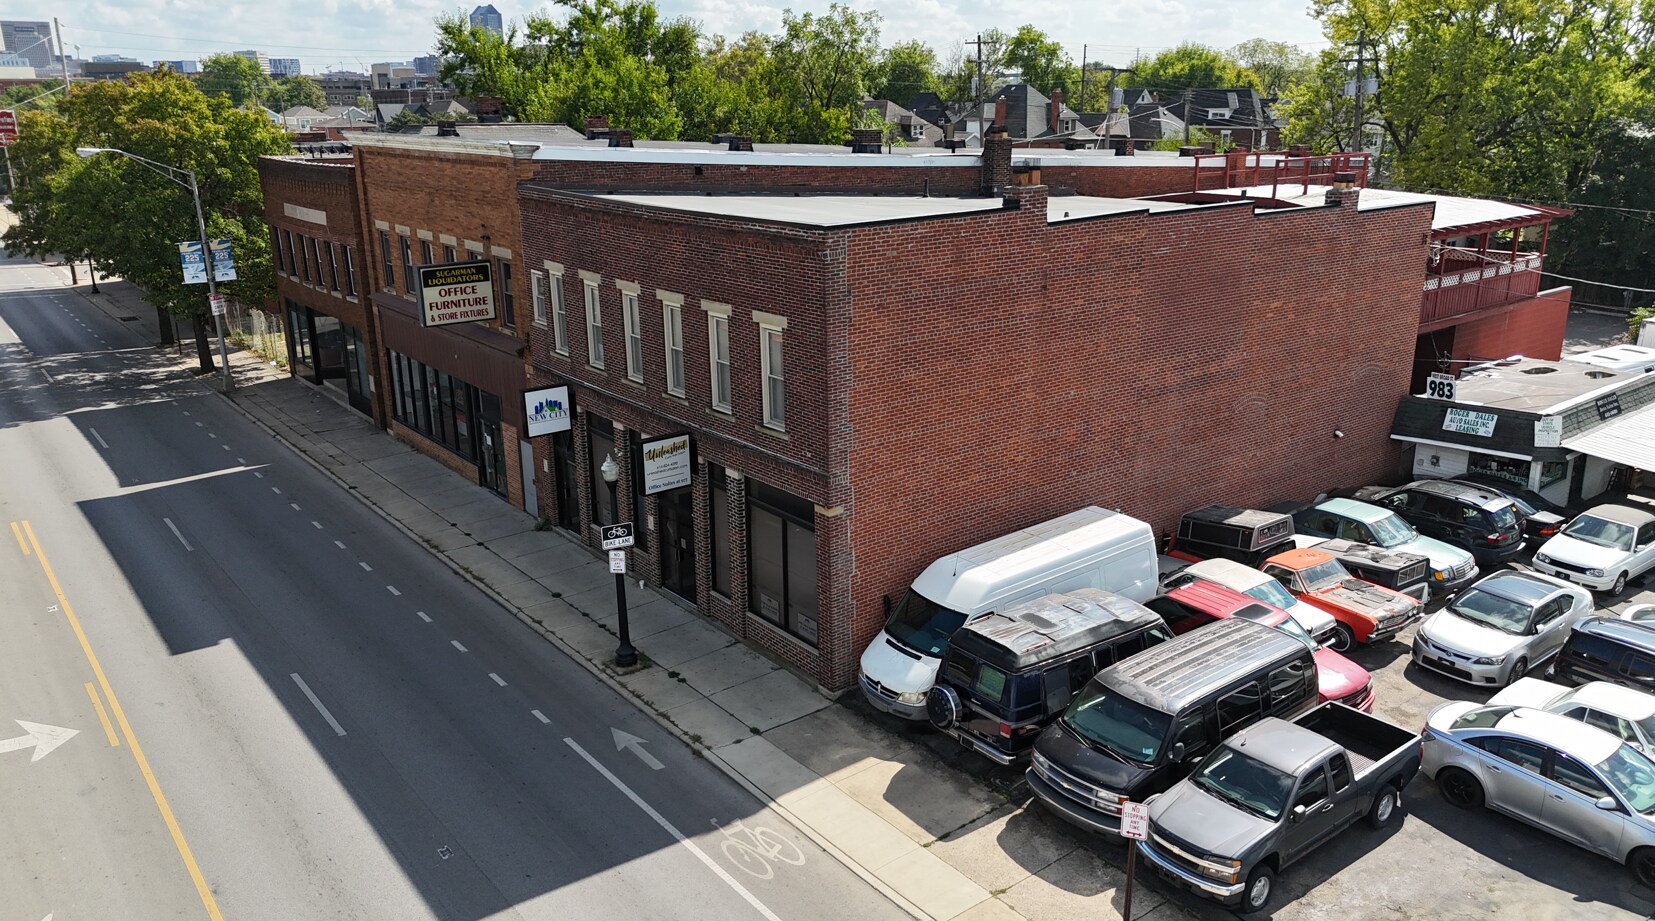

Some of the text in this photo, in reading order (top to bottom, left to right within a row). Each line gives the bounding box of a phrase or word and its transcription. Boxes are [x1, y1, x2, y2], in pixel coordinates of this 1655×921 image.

[185, 254, 200, 262] 225
[215, 252, 229, 260] 225
[436, 267, 476, 277] SUGARMAN
[428, 274, 484, 286] LIQUIDATORS
[438, 284, 478, 298] OFFICE
[429, 296, 489, 312] FURNITURE
[430, 308, 489, 323] & STORE FIXTURES
[1429, 379, 1454, 399] 983
[529, 408, 569, 422] NEW CITY
[1449, 409, 1495, 422] ROGER DALES
[1449, 416, 1463, 425] AUTO
[1463, 418, 1479, 427] SALES
[1455, 425, 1480, 435] LEASING
[645, 439, 687, 462] Unleashed
[605, 537, 631, 548] BIKE LANE
[1124, 812, 1147, 822] STOPPING
